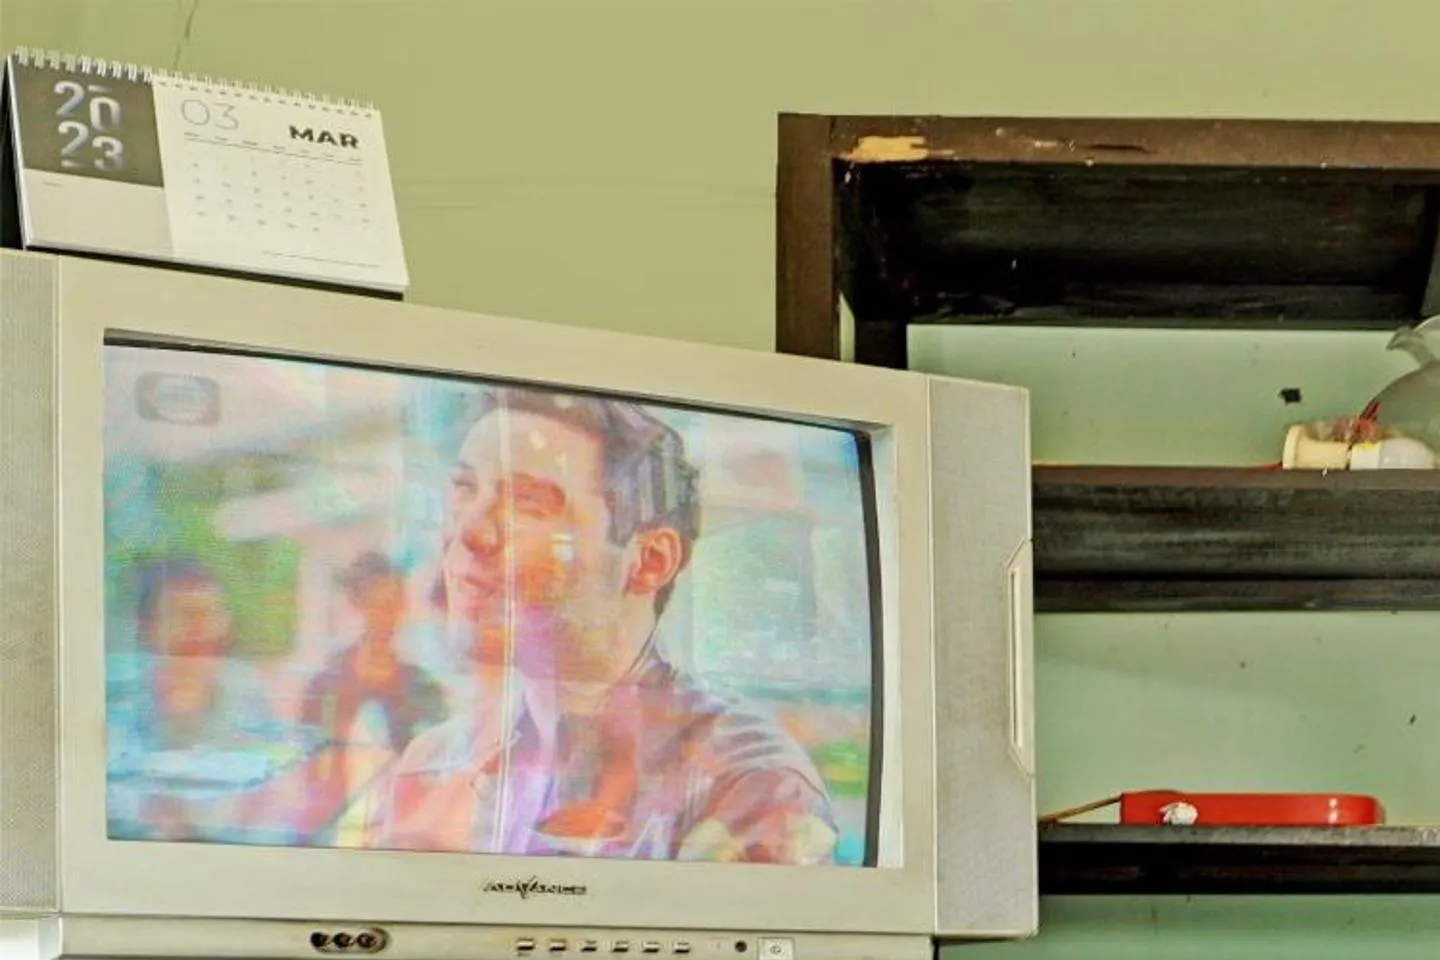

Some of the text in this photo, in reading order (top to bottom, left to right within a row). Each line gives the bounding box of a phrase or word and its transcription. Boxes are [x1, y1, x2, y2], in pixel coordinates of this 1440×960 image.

[54, 81, 121, 133] 20
[181, 100, 239, 129] 03
[289, 125, 359, 148] MAR
[58, 121, 123, 171] 23
